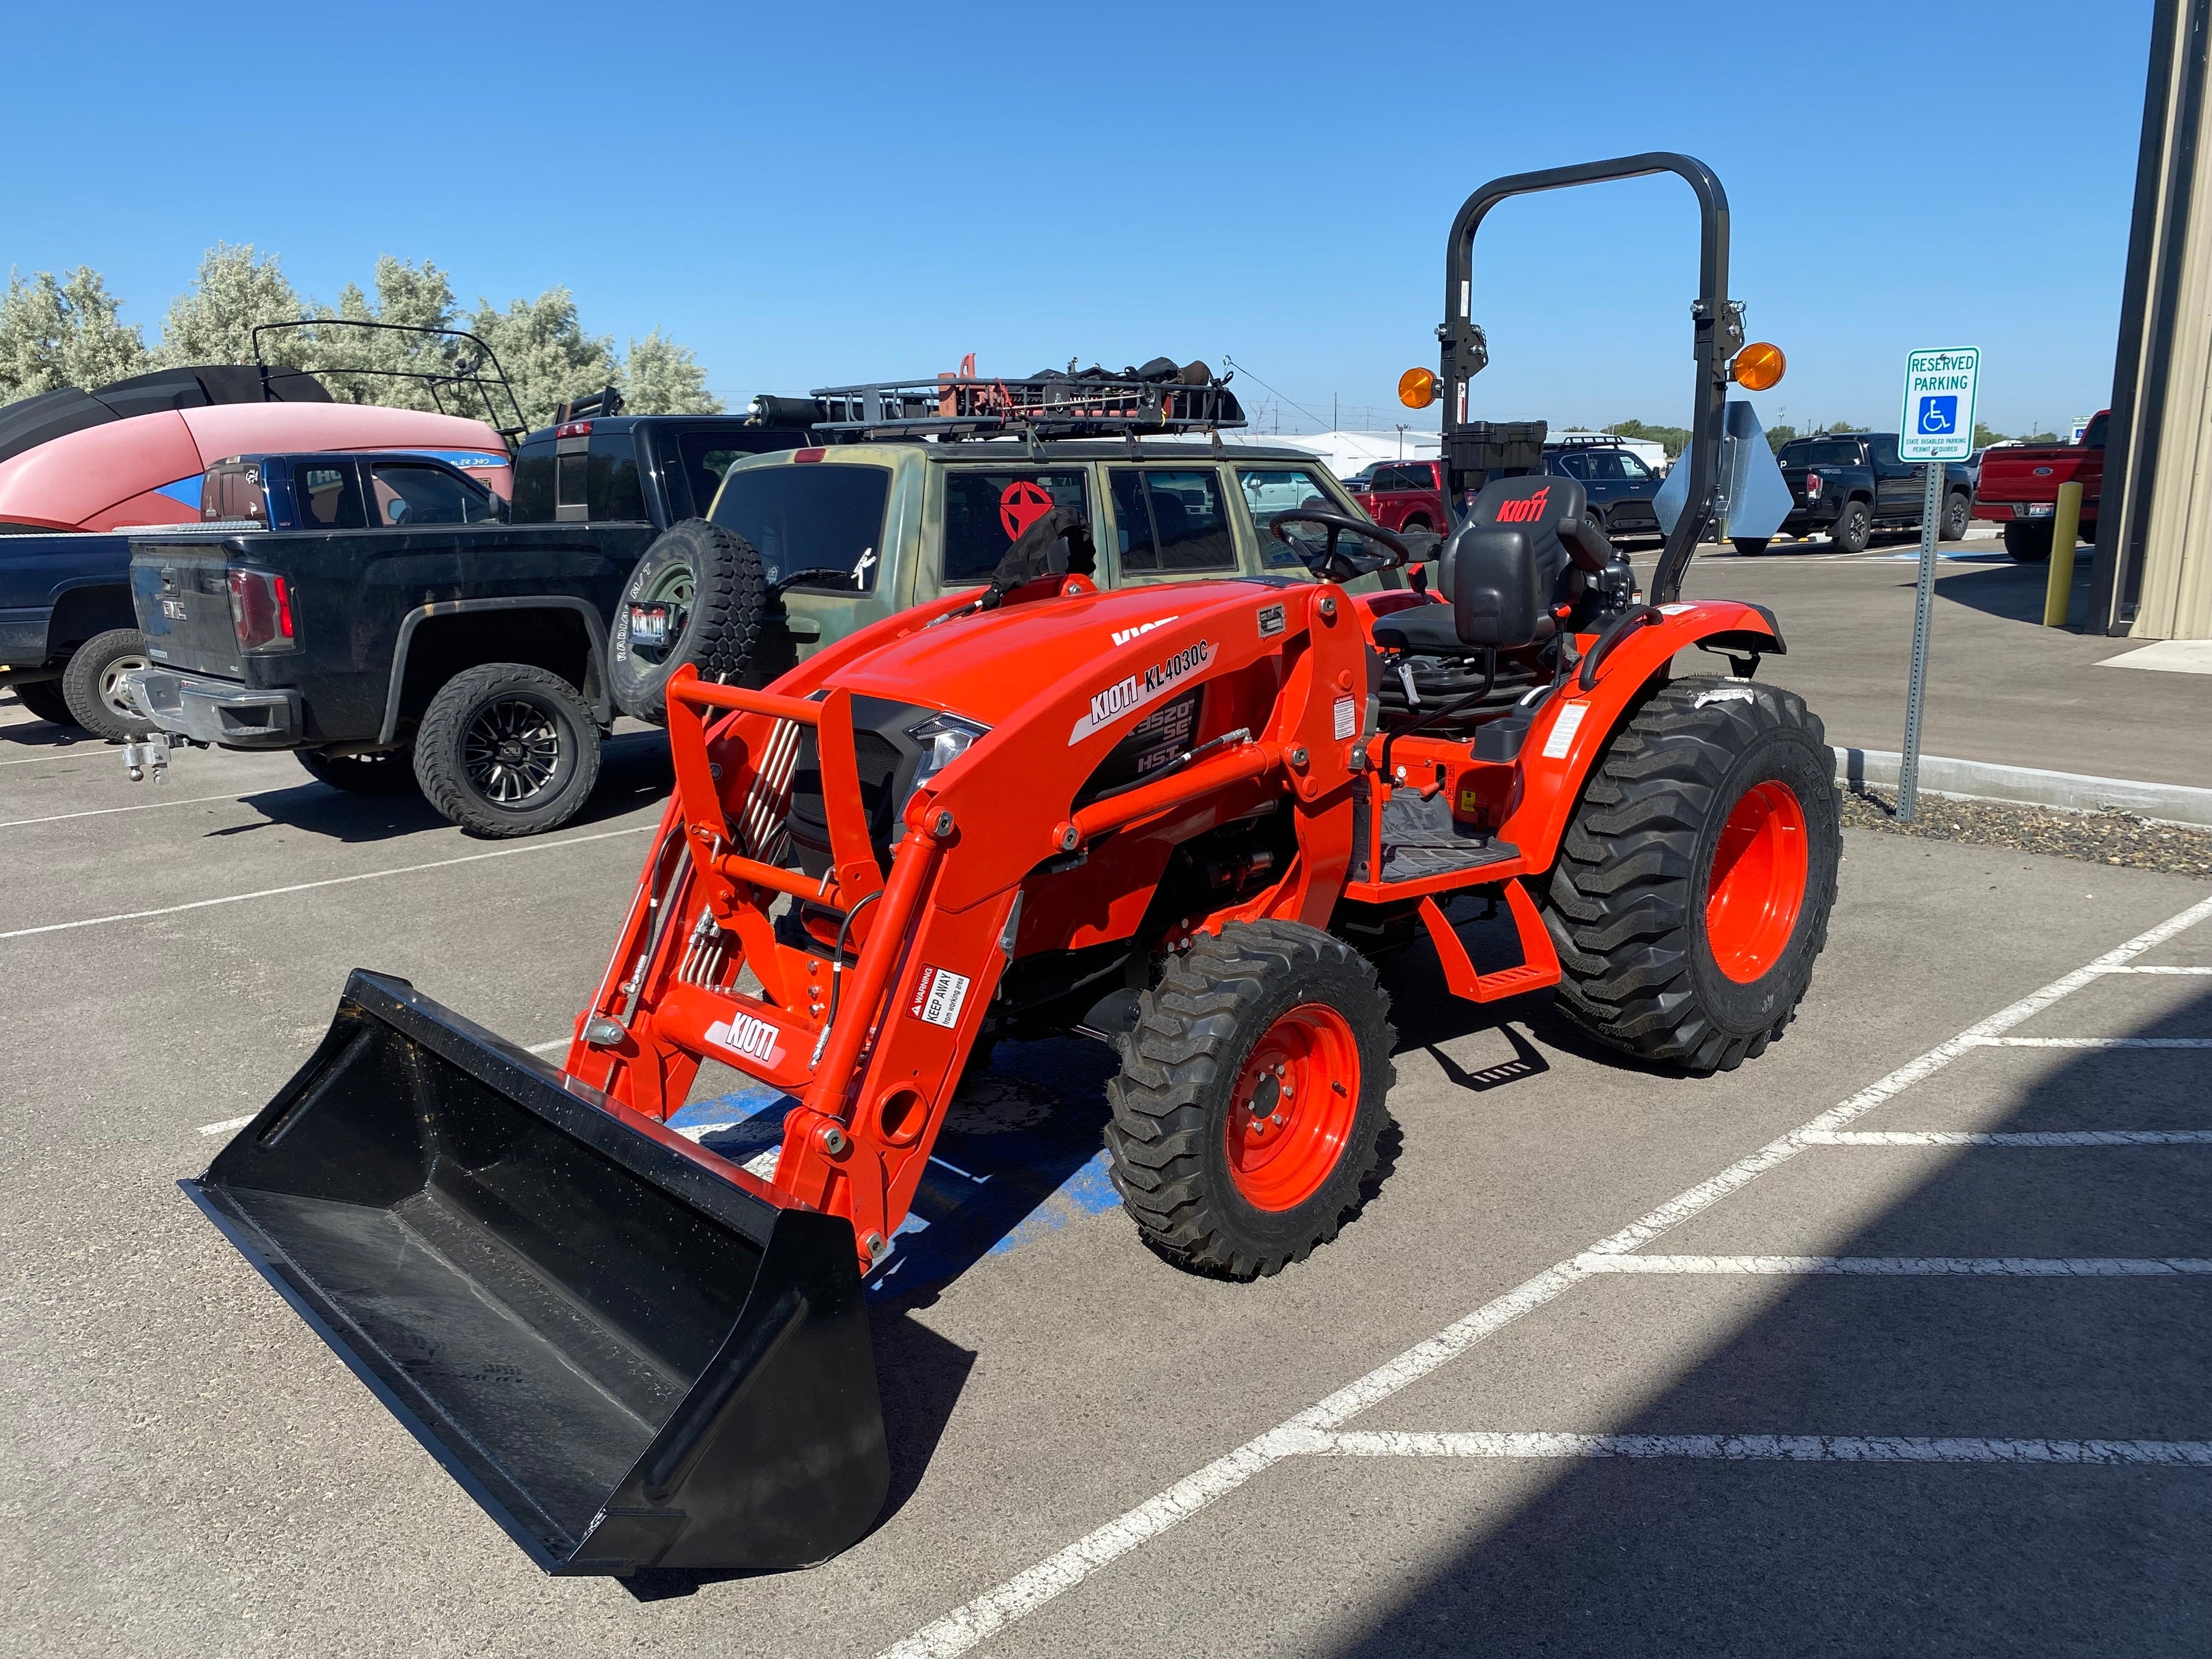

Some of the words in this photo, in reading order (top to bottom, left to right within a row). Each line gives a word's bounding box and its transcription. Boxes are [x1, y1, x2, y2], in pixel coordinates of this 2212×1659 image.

[1911, 355, 1974, 372] RESERVED
[1914, 375, 1968, 391] PARKING
[1495, 494, 1548, 522] KIOTI
[162, 600, 187, 622] GMC
[616, 605, 629, 662] RADIA
[1090, 674, 1138, 725] KIOTI
[1144, 639, 1209, 694] KL4030C
[1127, 702, 1190, 737] 3520
[1163, 718, 1188, 740] SE
[914, 968, 933, 1003] WARNING
[927, 999, 942, 1022] KEEP
[935, 972, 952, 999] AWAY
[942, 1012, 952, 1025] from
[948, 989, 961, 1012] working
[955, 978, 964, 990] area
[725, 1009, 781, 1062] KIOTI
